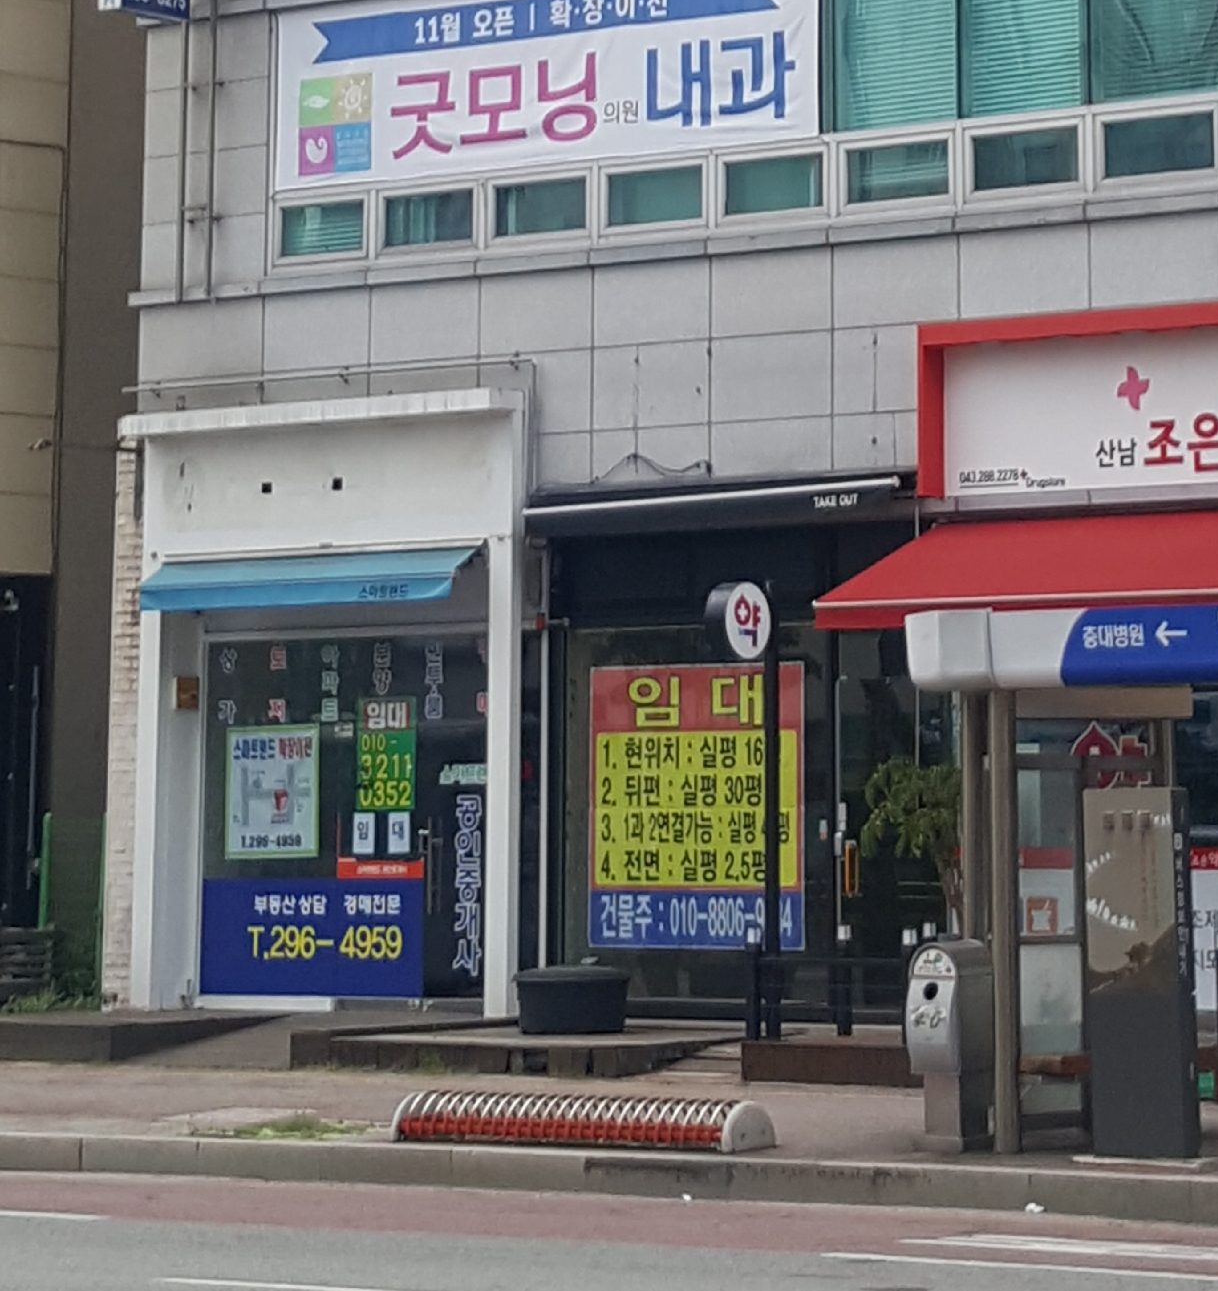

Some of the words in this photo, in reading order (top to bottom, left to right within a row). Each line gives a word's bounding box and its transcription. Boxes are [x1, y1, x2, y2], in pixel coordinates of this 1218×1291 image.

[414, 14, 460, 45] 11월
[473, 2, 514, 38] 오픈
[646, 30, 795, 127] 내과
[1096, 438, 1135, 468] 산남
[813, 495, 834, 510] TAKE
[837, 493, 858, 508] OUT
[734, 593, 761, 647] 약
[367, 702, 407, 729] 임대
[361, 754, 412, 781] 3211
[625, 737, 680, 770] 현위치
[700, 737, 737, 769] 실평
[625, 775, 660, 807] 뒤편
[681, 774, 717, 807] 실평
[725, 774, 762, 807] 30평
[728, 811, 757, 844] 실평
[624, 849, 660, 881] 전면
[681, 849, 717, 882] 실평
[453, 794, 482, 978] 공인중개사
[601, 894, 653, 939] 건물주
